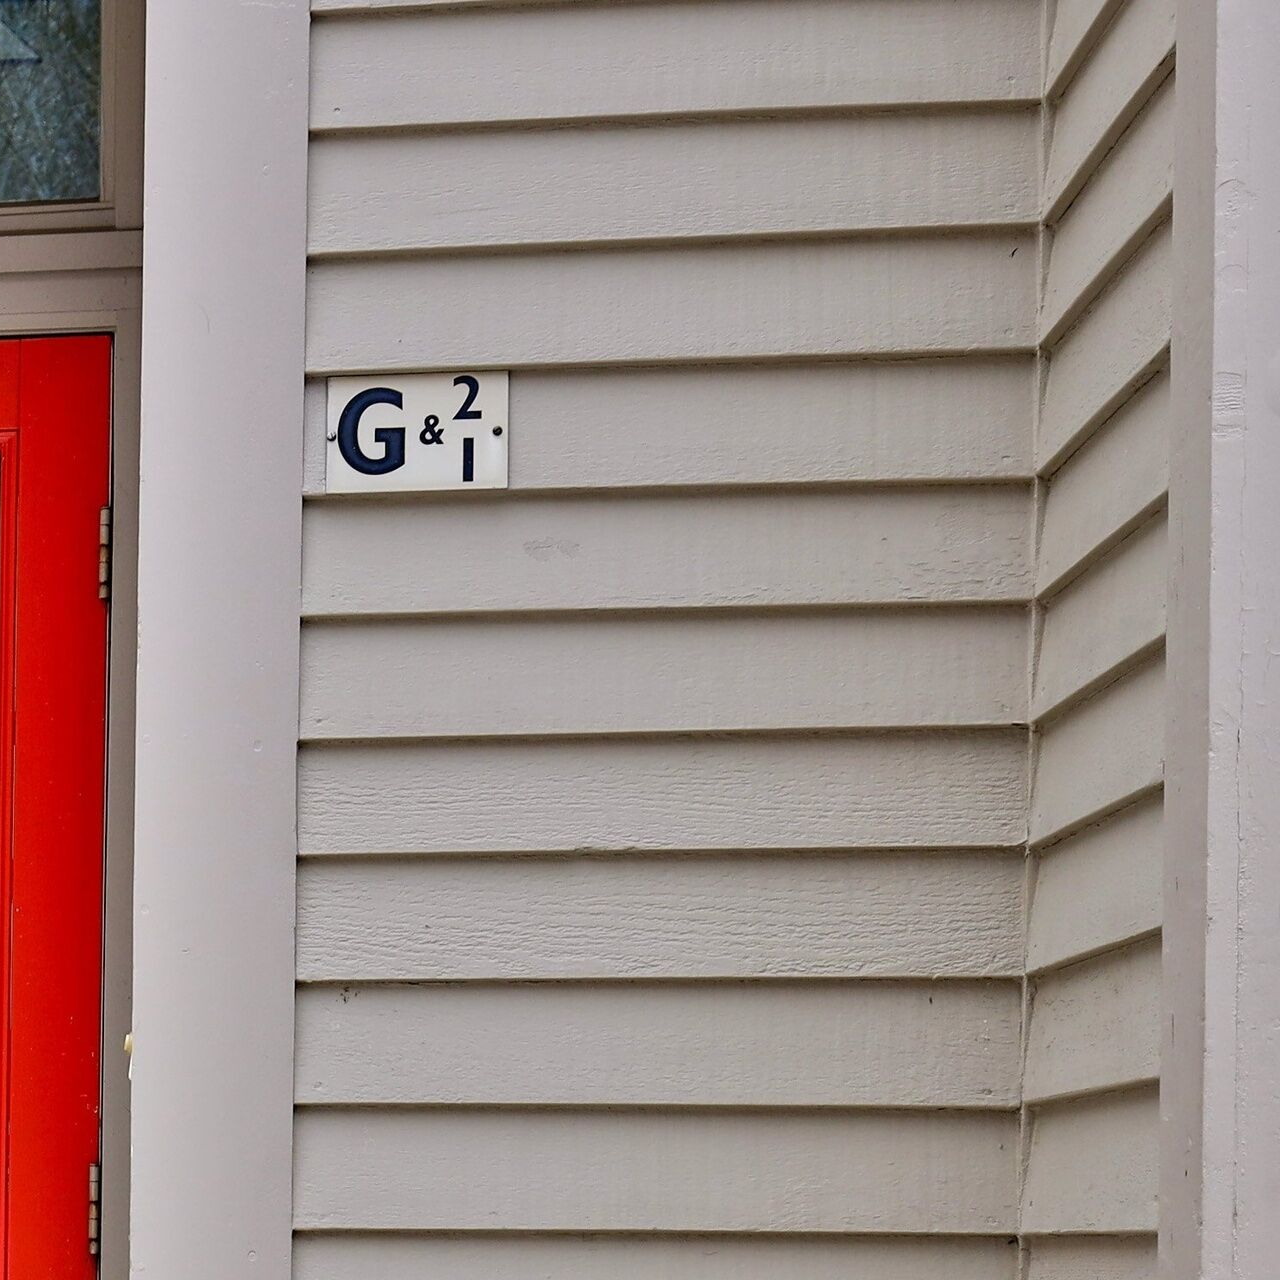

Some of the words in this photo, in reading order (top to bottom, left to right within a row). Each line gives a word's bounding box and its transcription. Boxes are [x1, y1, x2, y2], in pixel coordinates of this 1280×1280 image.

[337, 386, 406, 475] G
[419, 414, 445, 445] &
[452, 375, 482, 420] 2
